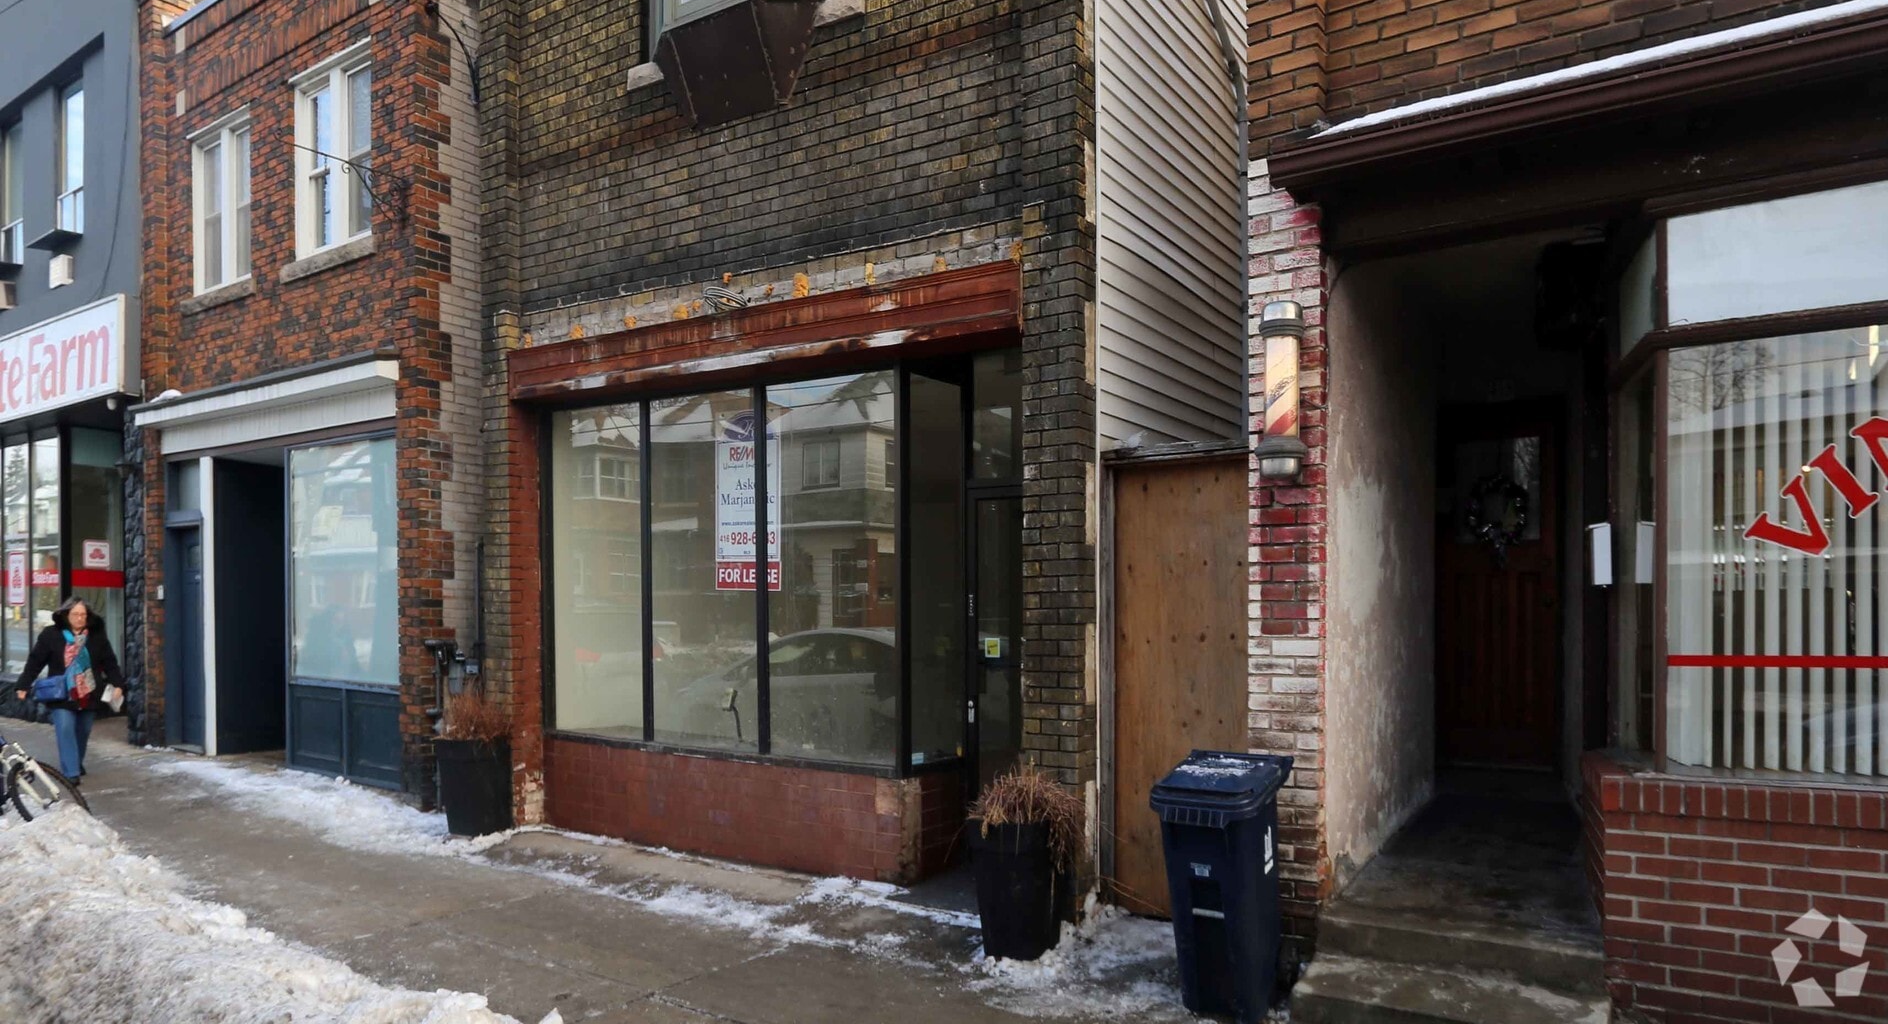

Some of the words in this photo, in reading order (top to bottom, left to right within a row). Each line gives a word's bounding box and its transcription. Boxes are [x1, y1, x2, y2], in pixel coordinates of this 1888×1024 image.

[735, 478, 756, 491] Ask
[721, 492, 775, 508] Marjanic
[719, 568, 741, 583] FOR
[743, 569, 778, 584] LEE
